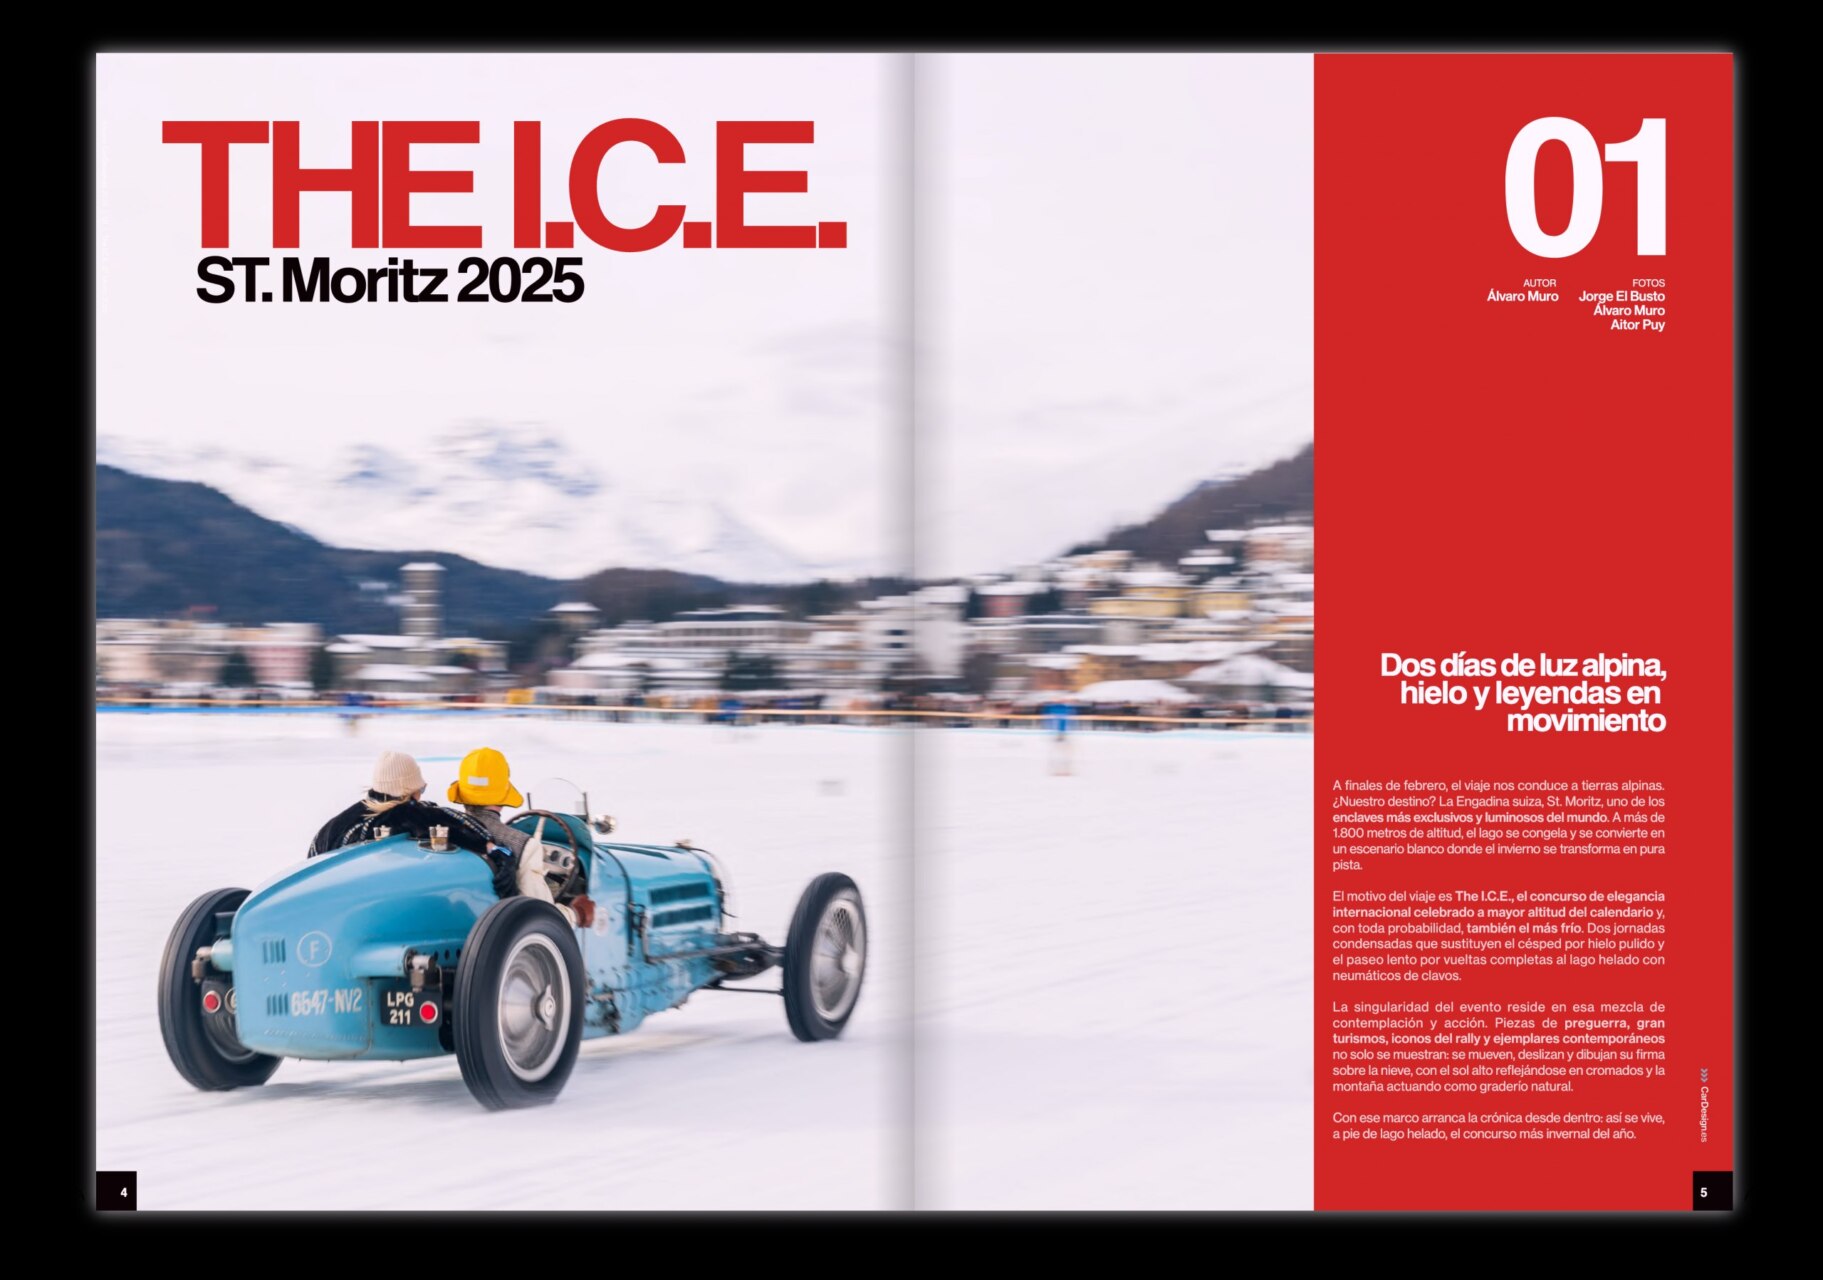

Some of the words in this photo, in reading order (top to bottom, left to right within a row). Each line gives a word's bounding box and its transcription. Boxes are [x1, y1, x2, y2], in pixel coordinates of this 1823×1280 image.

[162, 121, 482, 248] THE
[514, 118, 847, 252] I.C.E.
[1505, 117, 1666, 258] 01
[197, 256, 272, 303] ST.
[283, 256, 448, 303] Moritz
[457, 256, 584, 303] 2025
[1523, 279, 1556, 288] AUTOR
[1632, 279, 1665, 288] FOTOS
[1487, 288, 1525, 302] Álvaro
[1528, 291, 1559, 302] Muro
[1578, 290, 1614, 304] Jorge
[1616, 290, 1628, 301] El
[1630, 290, 1666, 302] Busto
[1593, 302, 1632, 316] Álvaro
[1634, 305, 1666, 316] Muro
[1610, 319, 1640, 330] Aitor
[1642, 319, 1666, 332] Puy
[1381, 653, 1436, 677] Dos
[1440, 651, 1496, 677] días
[1501, 653, 1535, 677] de
[1540, 653, 1578, 677] luz
[1582, 653, 1667, 682] alpina,
[1401, 681, 1468, 704] hielo
[1473, 686, 1490, 710] y
[1496, 681, 1622, 710] leyendas
[1626, 686, 1661, 704] en
[1507, 709, 1667, 732] movimiento
[1333, 780, 1342, 790] A
[1345, 780, 1383, 791] finales
[1385, 780, 1401, 791] de
[1403, 780, 1448, 792] febrero,
[1451, 780, 1461, 791] el
[1464, 780, 1491, 793] viaje
[1493, 782, 1515, 791] nos
[1517, 780, 1568, 791] conduce
[1571, 782, 1578, 791] a
[1581, 780, 1619, 791] tierras
[1621, 780, 1664, 793] alpinas.
[1332, 812, 1384, 823] enclaves
[1386, 811, 1411, 823] más
[1413, 812, 1474, 823] exclusivos
[1475, 814, 1483, 825] y
[1485, 812, 1544, 823] luminosos
[1546, 812, 1564, 823] del
[1567, 812, 1610, 823] mundo.
[1612, 811, 1621, 822] A
[1624, 811, 1648, 823] más
[1650, 812, 1665, 823] de
[1333, 859, 1362, 872] pista.
[1333, 890, 1344, 901] El
[1347, 891, 1386, 902] motivo
[1388, 891, 1407, 902] del
[1409, 891, 1436, 903] viaje
[1438, 893, 1453, 902] es
[1455, 890, 1479, 902] The
[1481, 890, 1514, 903] I.C.E.,
[1516, 890, 1527, 902] el
[1529, 893, 1587, 902] concurso
[1589, 891, 1605, 902] de
[1607, 891, 1665, 904] elegancia
[1333, 906, 1411, 918] internacional
[1413, 906, 1475, 918] celebrado
[1477, 909, 1485, 917] a
[1487, 909, 1525, 920] mayor
[1528, 906, 1566, 918] altitud
[1568, 906, 1587, 918] del
[1590, 906, 1654, 918] calendario
[1656, 909, 1665, 920] y,
[1332, 925, 1355, 933] con
[1358, 923, 1385, 934] toda
[1388, 922, 1464, 935] probabilidad,
[1466, 922, 1516, 934] también
[1519, 922, 1529, 933] el
[1532, 922, 1558, 934] más
[1560, 922, 1584, 934] frío.
[1587, 922, 1611, 934] Dos
[1613, 922, 1665, 935] jornadas
[1333, 970, 1401, 981] neumáticos
[1404, 970, 1419, 981] de
[1421, 970, 1461, 981] clavos.
[387, 992, 414, 1007] LPG
[1333, 1001, 1348, 1012] La
[1354, 1001, 1429, 1015] singularidad
[1435, 1001, 1454, 1012] del
[1460, 1002, 1502, 1012] evento
[1507, 1001, 1545, 1012] reside
[1551, 1004, 1566, 1012] en
[1573, 1004, 1595, 1012] esa
[1601, 1001, 1644, 1012] mezcla
[1650, 1001, 1665, 1012] de
[390, 1009, 411, 1024] 211
[1333, 1017, 1423, 1030] contemplación
[1430, 1020, 1437, 1030] y
[1444, 1017, 1488, 1028] acción.
[1495, 1017, 1535, 1028] Piezas
[1542, 1017, 1558, 1028] de
[1565, 1019, 1630, 1030] preguerra,
[1637, 1020, 1665, 1030] gran
[1333, 1033, 1389, 1045] turismos,
[1391, 1033, 1432, 1044] iconos
[1434, 1033, 1453, 1044] del
[1455, 1033, 1481, 1046] rally
[1483, 1035, 1491, 1046] y
[1493, 1033, 1560, 1046] ejemplares
[1562, 1032, 1665, 1046] contemporáneos
[1333, 1051, 1348, 1060] no
[1350, 1049, 1374, 1060] solo
[1377, 1051, 1391, 1060] se
[1393, 1049, 1449, 1060] muestran:
[1452, 1051, 1466, 1060] se
[1468, 1051, 1515, 1061] mueven,
[1518, 1049, 1565, 1060] deslizan
[1567, 1051, 1574, 1062] y
[1576, 1049, 1617, 1062] dibujan
[1620, 1051, 1633, 1060] su
[1636, 1049, 1665, 1060] firma
[1333, 1081, 1384, 1092] montaña
[1386, 1081, 1442, 1092] actuando
[1444, 1083, 1477, 1092] como
[1479, 1080, 1528, 1094] graderío
[1531, 1081, 1573, 1092] natural.
[1333, 1112, 1357, 1123] Con
[1359, 1114, 1380, 1123] ese
[1383, 1114, 1419, 1123] marco
[1422, 1114, 1466, 1123] arranca
[1468, 1112, 1478, 1123] la
[1480, 1112, 1523, 1123] crónica
[1525, 1112, 1561, 1123] desde
[1563, 1112, 1603, 1123] dentro:
[1605, 1112, 1622, 1123] así
[1624, 1114, 1638, 1123] se
[1640, 1112, 1665, 1124] vive,
[1699, 1086, 1709, 1143] CarDesign.es
[1333, 1130, 1340, 1139] a
[1343, 1128, 1360, 1141] pie
[1362, 1128, 1377, 1139] de
[1380, 1128, 1405, 1141] lago
[1407, 1128, 1448, 1140] helado,
[1450, 1128, 1460, 1139] el
[1463, 1130, 1517, 1139] concurso
[1519, 1128, 1544, 1139] más
[1546, 1128, 1590, 1139] invernal
[1592, 1128, 1610, 1139] del
[1612, 1128, 1636, 1139] año.
[120, 1187, 128, 1198] 4
[1700, 1187, 1708, 1198] 5
